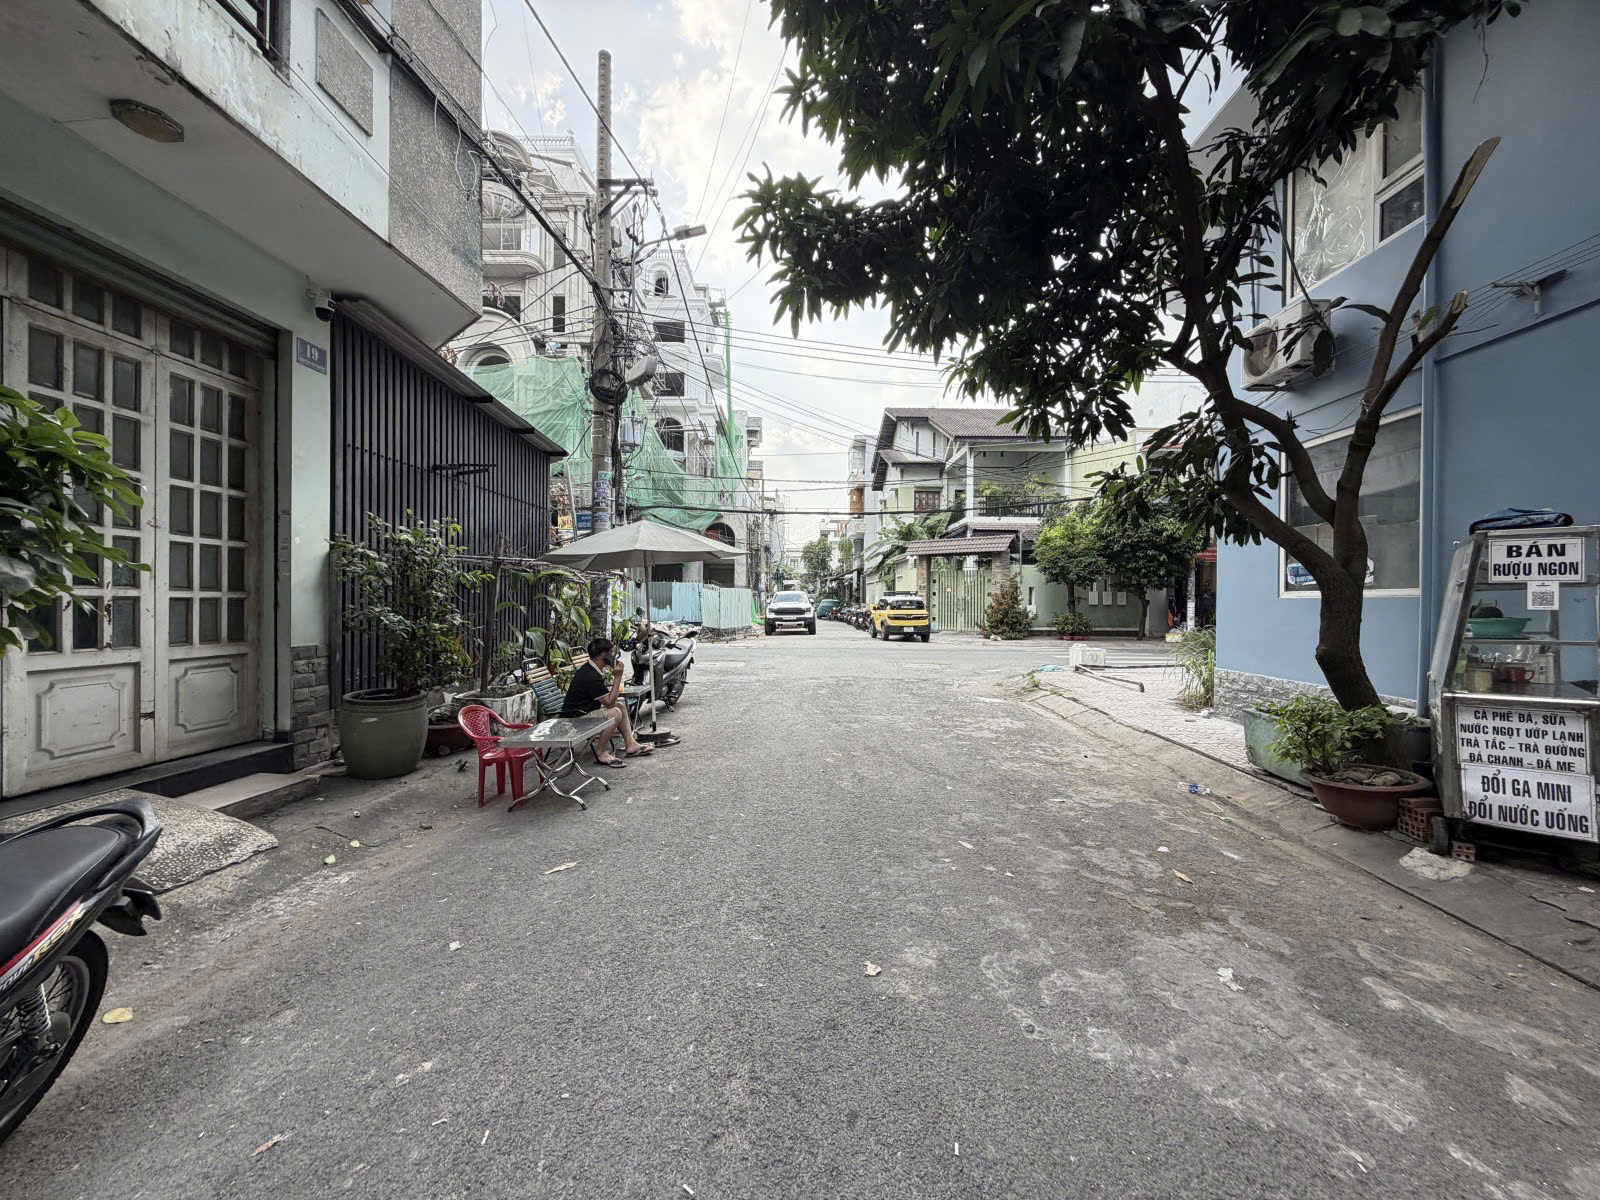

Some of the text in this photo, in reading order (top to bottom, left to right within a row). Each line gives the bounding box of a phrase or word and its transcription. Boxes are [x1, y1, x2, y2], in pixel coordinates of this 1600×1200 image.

[306, 344, 319, 361] 19
[1506, 541, 1566, 558] BÁN
[1493, 561, 1579, 579] RƯỢU NGON
[1474, 710, 1488, 720] CÀ
[1492, 711, 1514, 722] PHÊ
[1542, 714, 1566, 726] SỮA
[1460, 723, 1584, 743] NƯỚC NGỌT ƯỚP LẠNH
[1460, 737, 1479, 748] TRÀ
[1485, 738, 1506, 750] TẮC
[1518, 742, 1539, 753] TRÀ
[1545, 744, 1585, 757] ĐƯỜNG
[1469, 751, 1483, 763] ĐÁ
[1487, 754, 1523, 767] CHANH
[1537, 758, 1552, 770] ĐÁ
[1557, 761, 1576, 772] ME
[1481, 769, 1506, 794] ĐỔI
[1512, 778, 1531, 798] GA
[1537, 782, 1572, 803] MINI
[1468, 795, 1589, 834] ĐỔI NƯỚC UỐNG
[0, 958, 33, 991] ave
